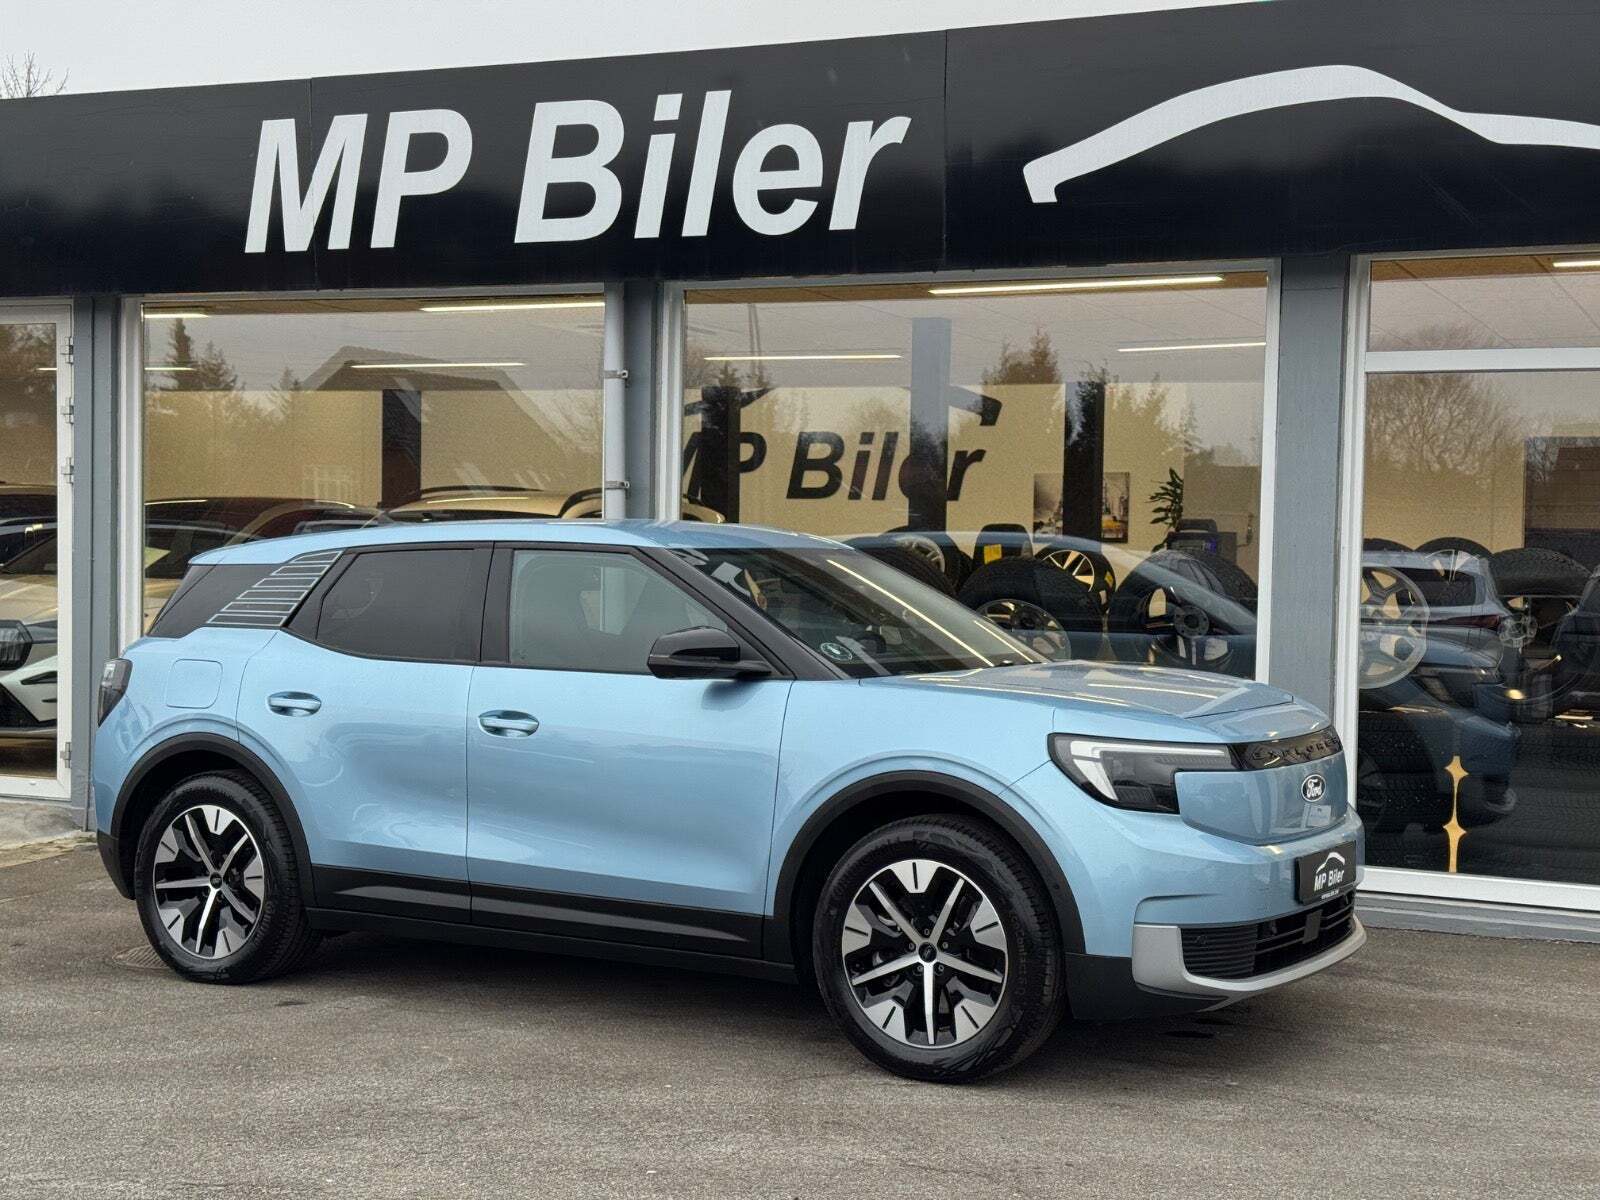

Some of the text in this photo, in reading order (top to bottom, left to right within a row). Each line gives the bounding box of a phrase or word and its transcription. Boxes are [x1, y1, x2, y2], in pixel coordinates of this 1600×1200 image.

[244, 89, 912, 254] MP Biler
[786, 431, 987, 502] Bilr
[1305, 778, 1323, 799] Ford
[1314, 868, 1345, 892] MP Biler
